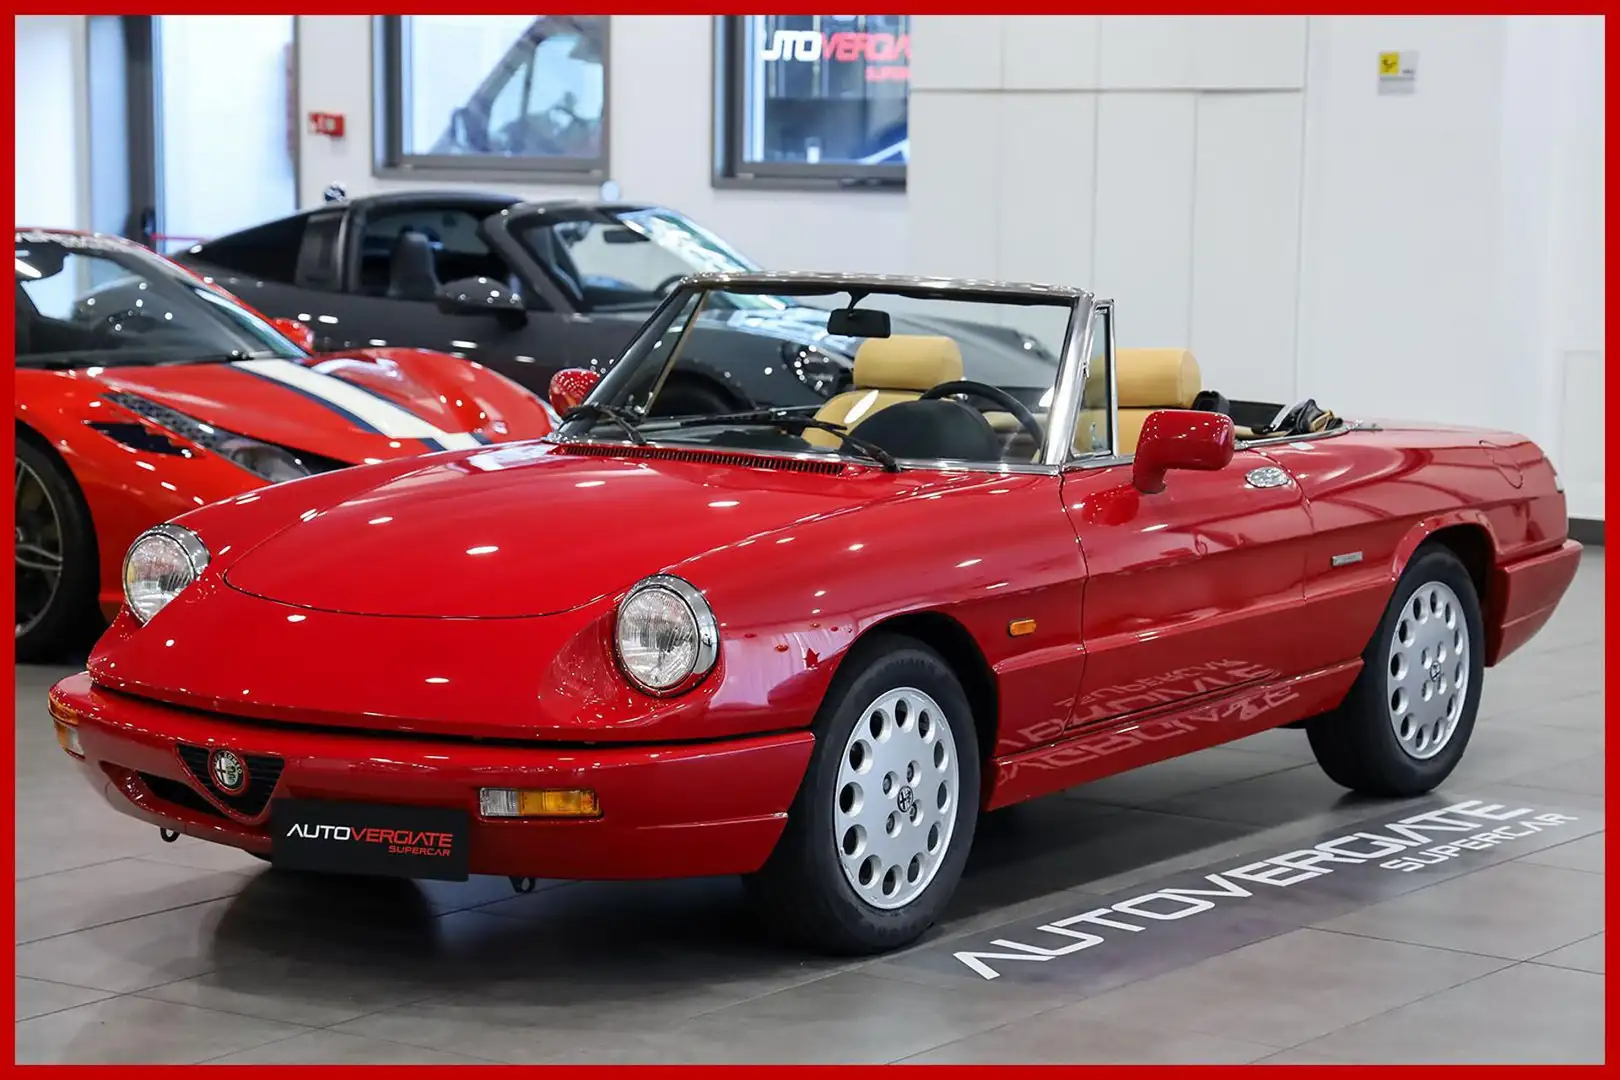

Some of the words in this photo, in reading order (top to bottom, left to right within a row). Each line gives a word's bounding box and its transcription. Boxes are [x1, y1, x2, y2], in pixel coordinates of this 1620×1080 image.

[286, 823, 454, 848] AUTOVERGIATE
[388, 845, 452, 857] SUPERCAR
[1380, 812, 1579, 873] SUPERCAR
[953, 799, 1533, 980] AUTOVERGIATE
